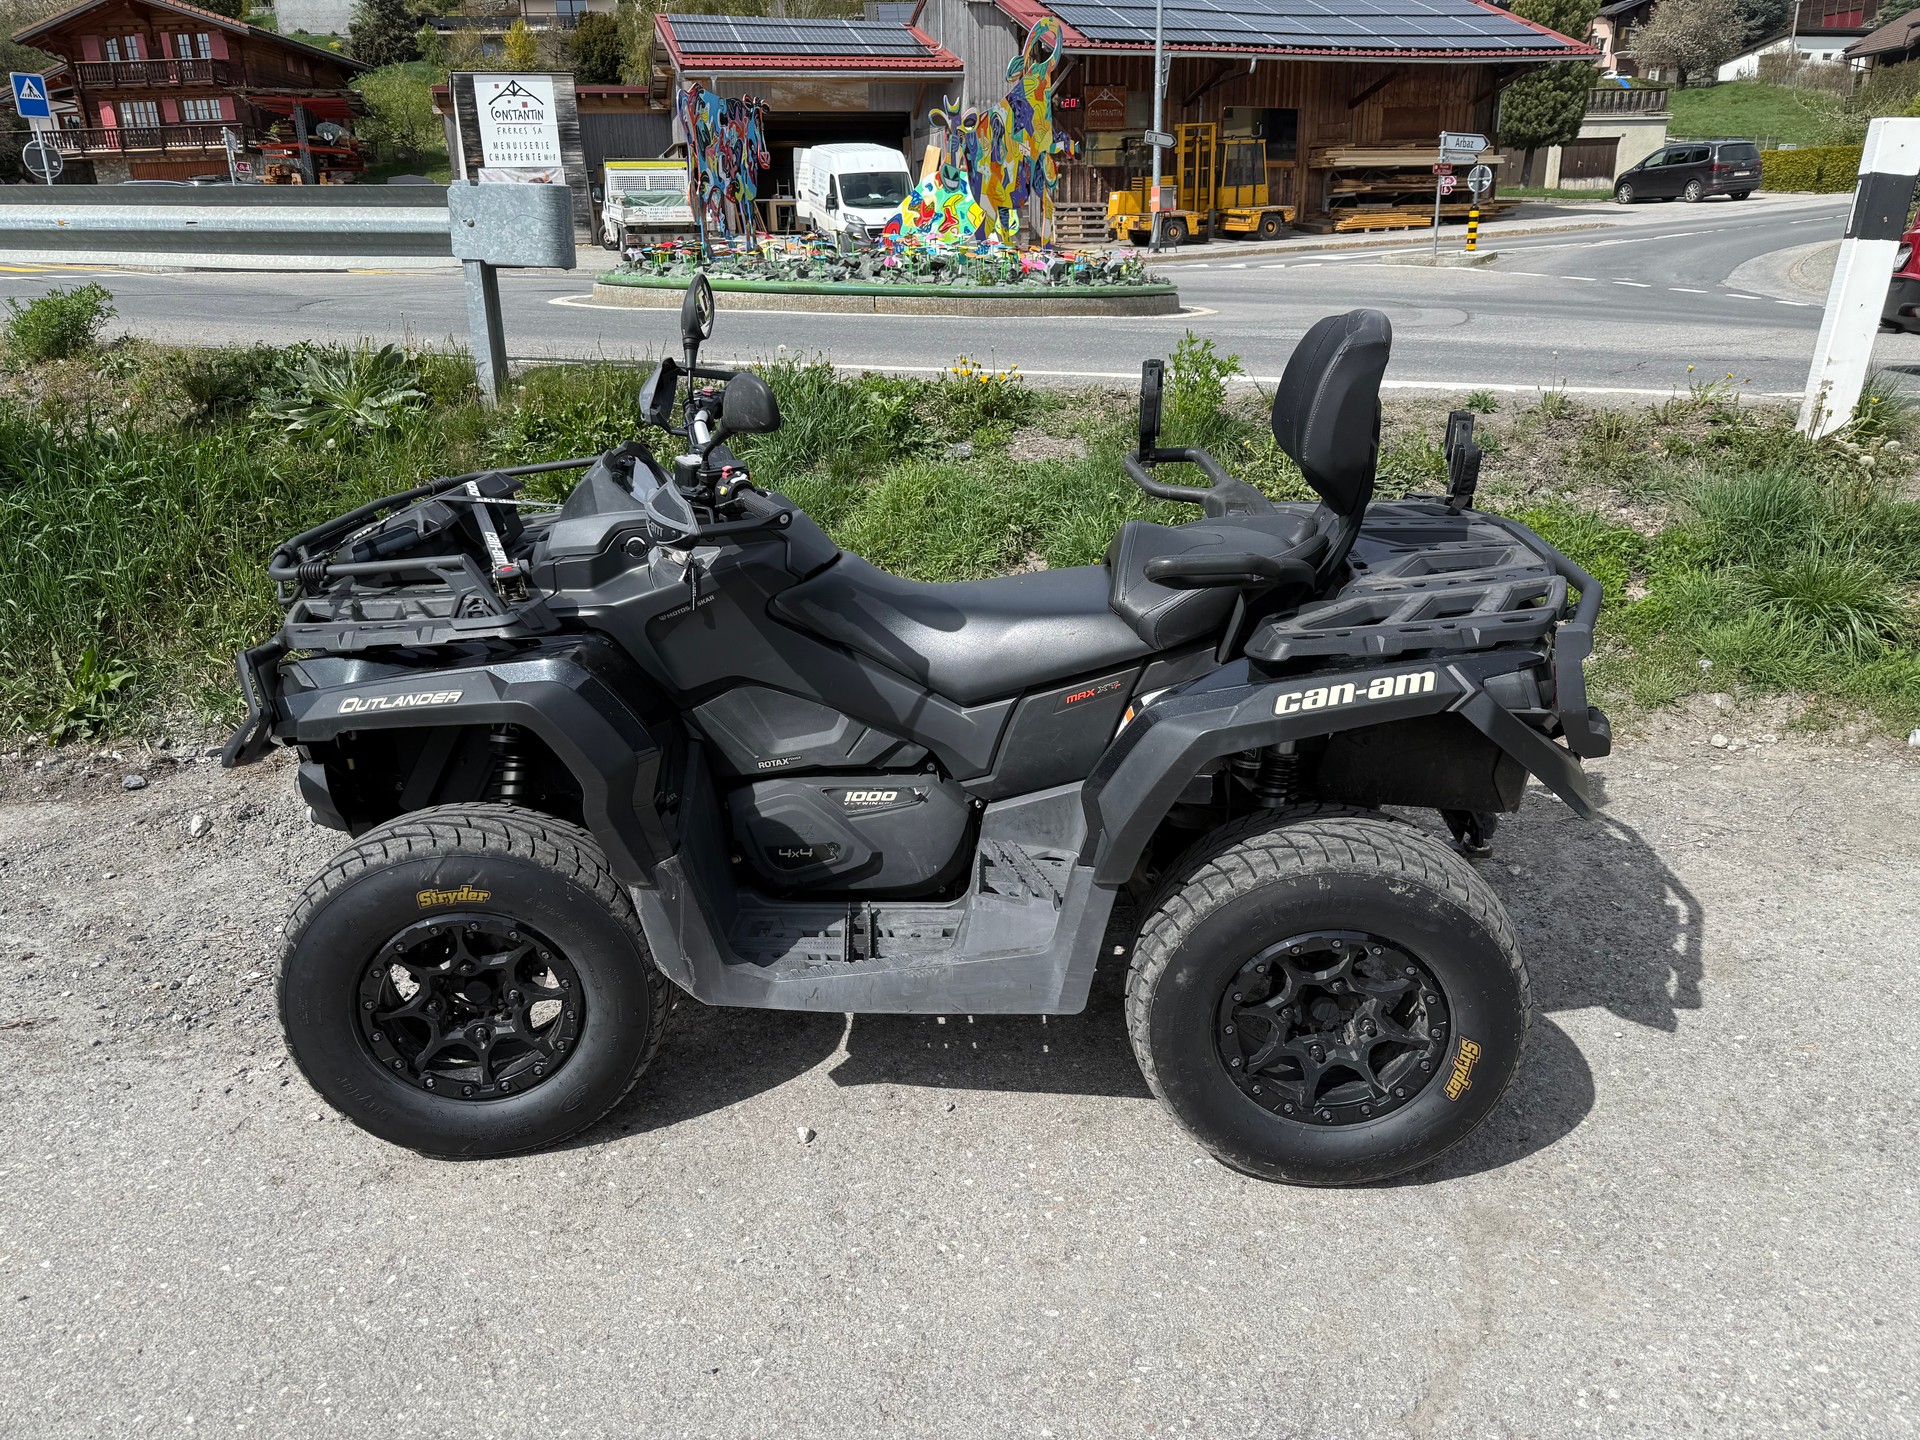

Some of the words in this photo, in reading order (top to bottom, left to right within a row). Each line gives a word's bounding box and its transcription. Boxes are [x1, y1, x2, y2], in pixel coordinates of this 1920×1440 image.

[532, 126, 543, 135] SA
[493, 141, 550, 150] MENUISERIE
[1455, 137, 1474, 149] Arbaz
[488, 152, 542, 162] CHARPENTE
[696, 594, 715, 607] SKAR
[1066, 688, 1096, 704] MAX
[1274, 671, 1436, 716] can-am
[339, 690, 463, 714] OUTLANDER
[757, 758, 789, 770] ROTAX
[844, 791, 899, 802] 1000
[778, 847, 814, 859] 4x4
[417, 885, 491, 908] Stryder
[1443, 1036, 1482, 1101] Stryder
